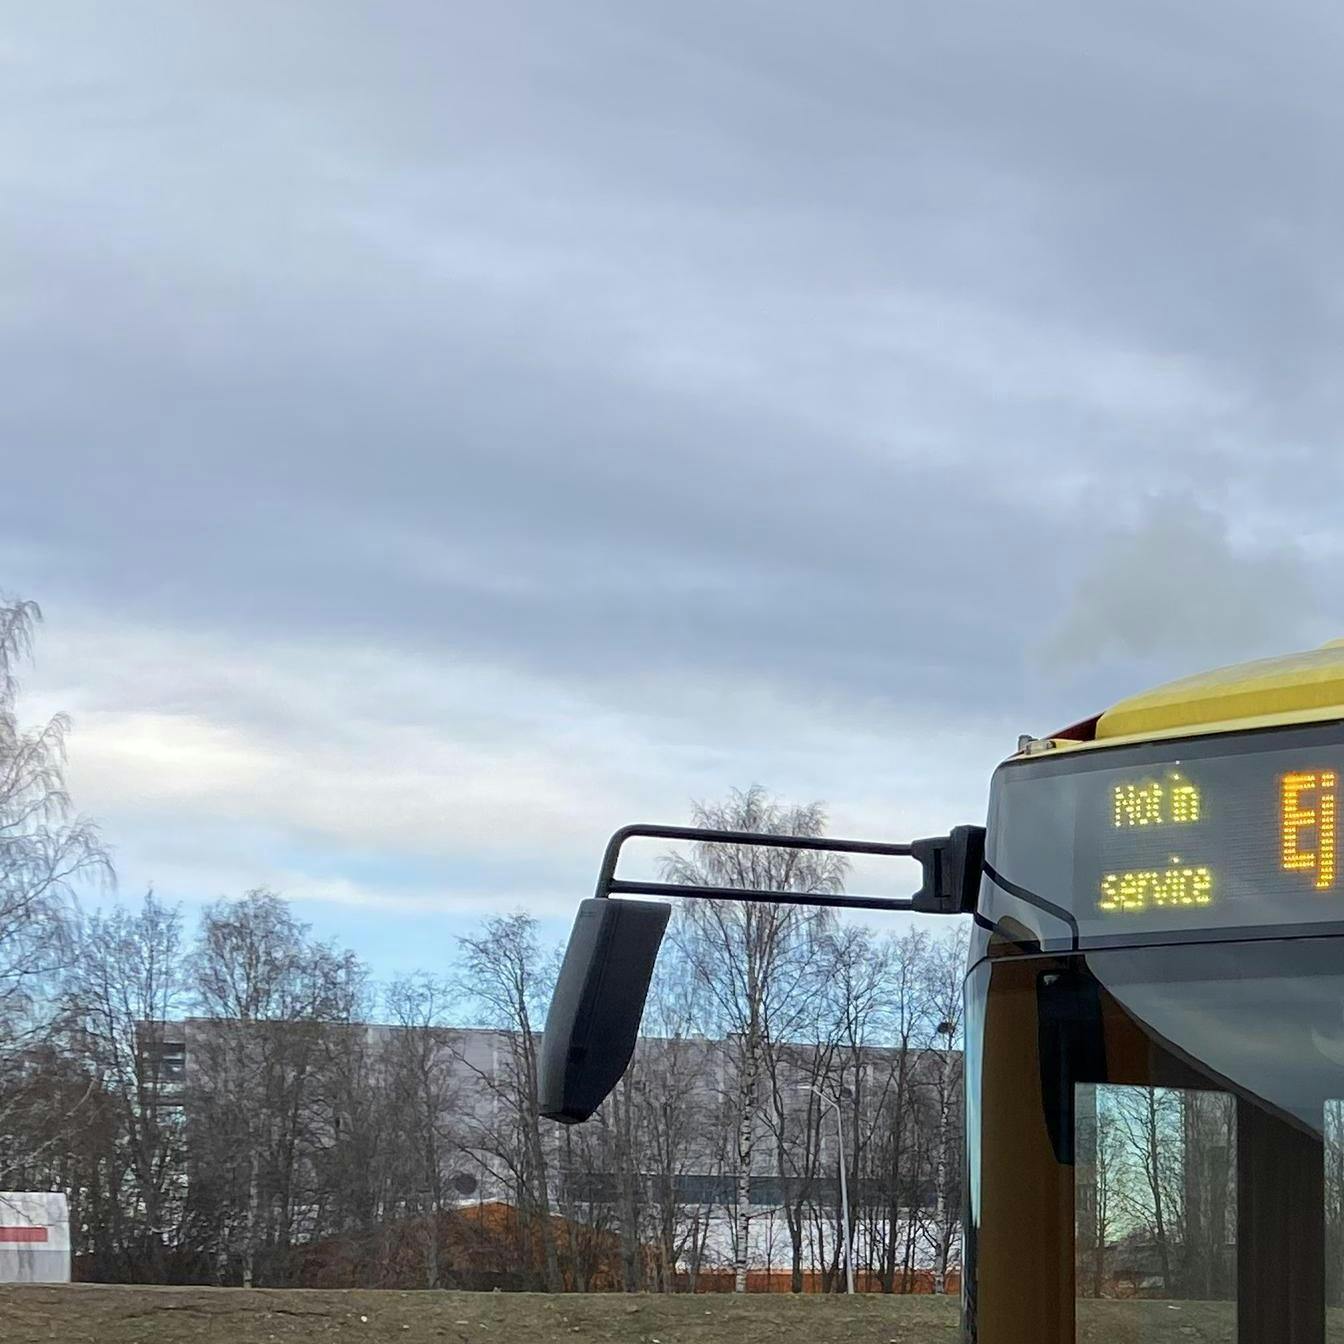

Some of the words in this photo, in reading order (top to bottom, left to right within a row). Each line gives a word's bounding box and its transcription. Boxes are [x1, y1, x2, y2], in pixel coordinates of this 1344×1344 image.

[1114, 783, 1164, 828] Not
[1172, 774, 1200, 822] in
[1283, 772, 1335, 889] Ej
[1101, 857, 1212, 909] service
